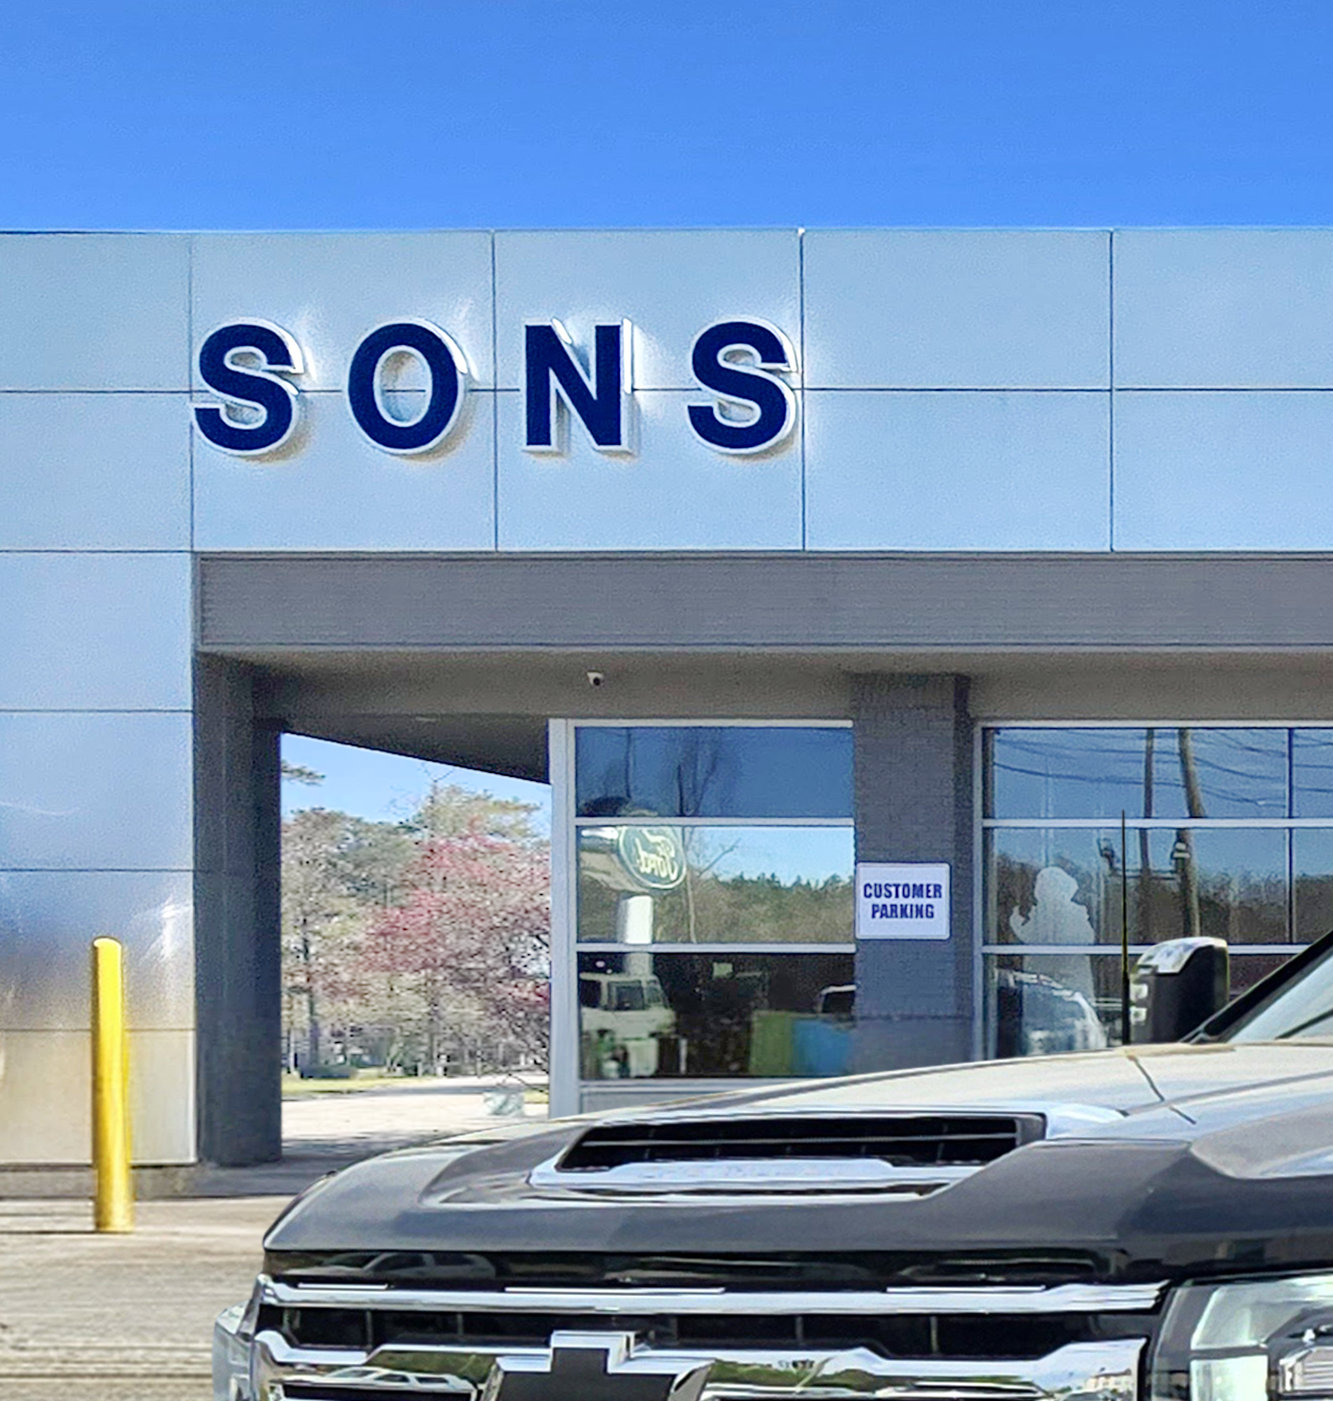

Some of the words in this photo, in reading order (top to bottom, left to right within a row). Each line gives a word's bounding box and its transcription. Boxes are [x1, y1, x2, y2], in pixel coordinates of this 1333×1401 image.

[194, 319, 795, 456] SONS
[863, 883, 943, 899] CUSTOMER
[871, 903, 935, 919] PARKING
